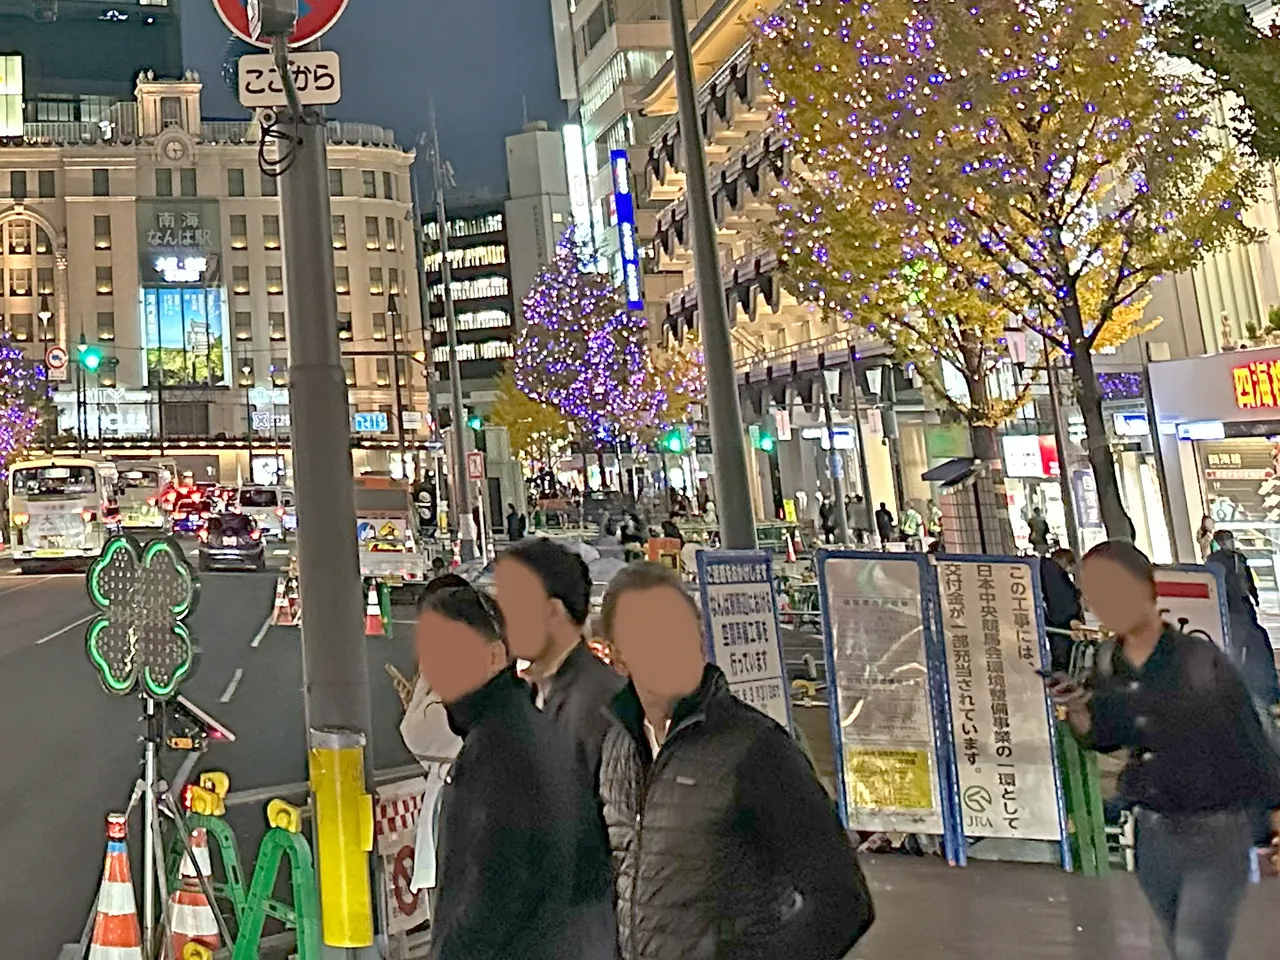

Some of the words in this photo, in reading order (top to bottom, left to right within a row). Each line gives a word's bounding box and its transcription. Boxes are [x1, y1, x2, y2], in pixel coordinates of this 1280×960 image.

[245, 61, 336, 94] ここから
[147, 229, 213, 246] なんば駅
[967, 816, 993, 829] JRA
